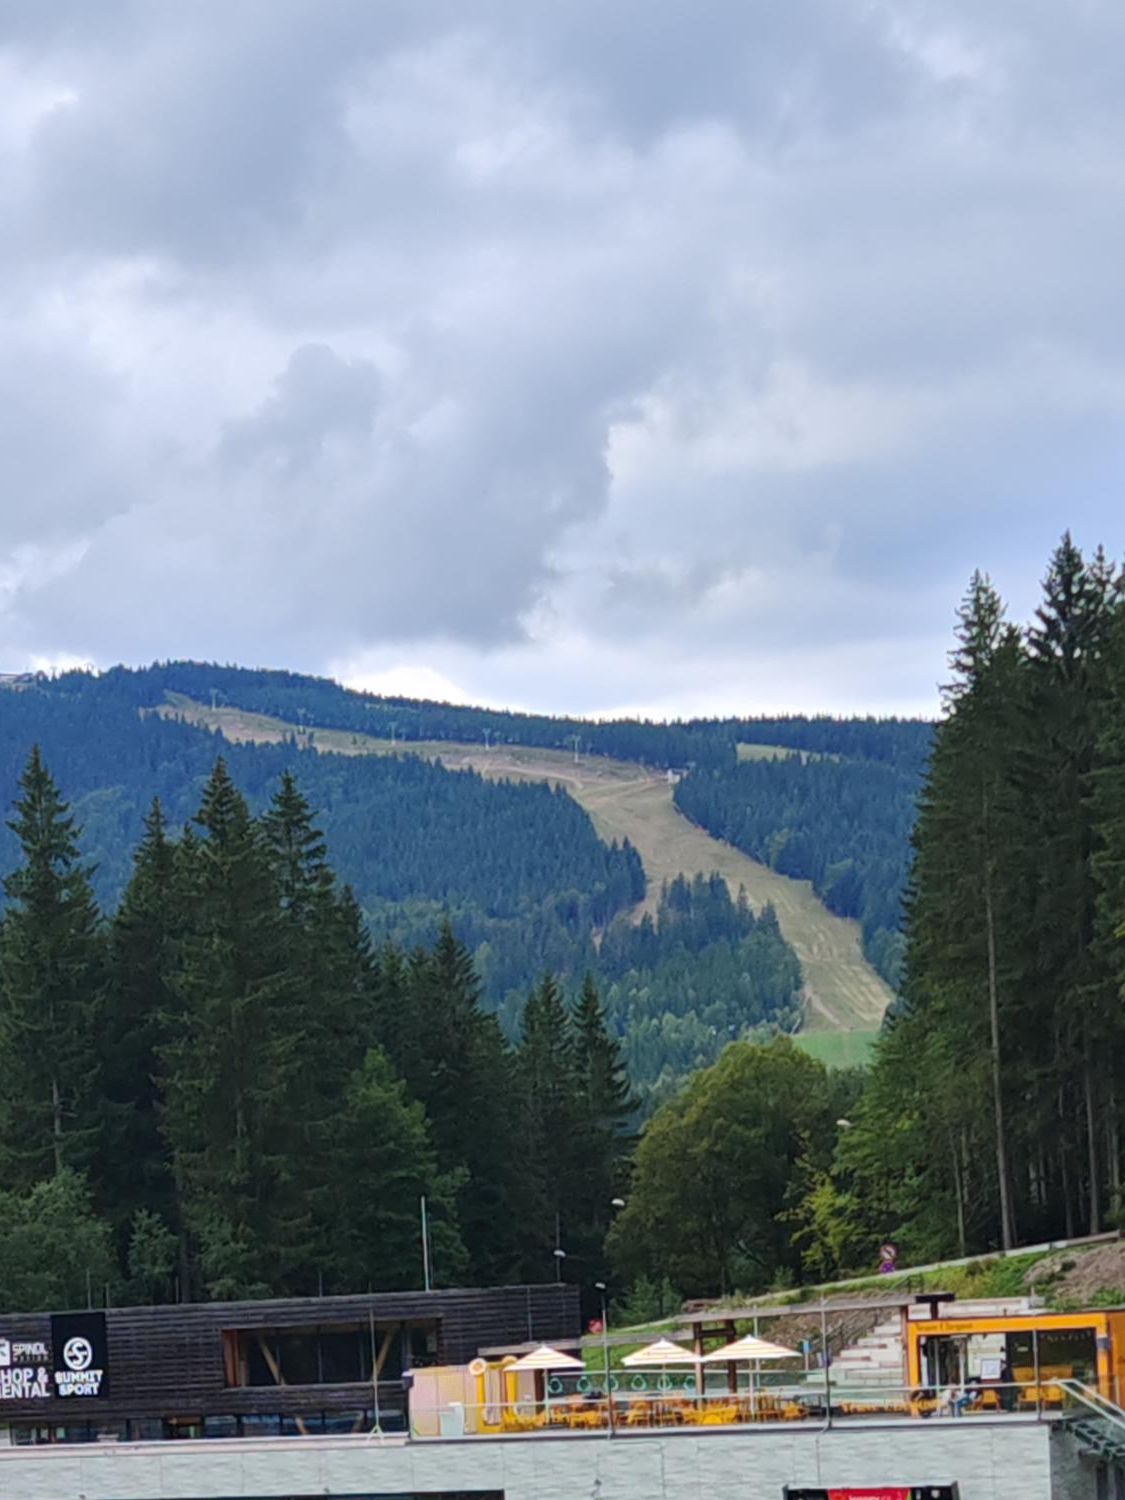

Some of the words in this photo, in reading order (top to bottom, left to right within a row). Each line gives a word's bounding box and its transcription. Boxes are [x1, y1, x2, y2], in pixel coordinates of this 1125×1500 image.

[37, 1367, 48, 1383] &
[55, 1370, 103, 1384] SUMMIT
[59, 1383, 100, 1396] SPORT
